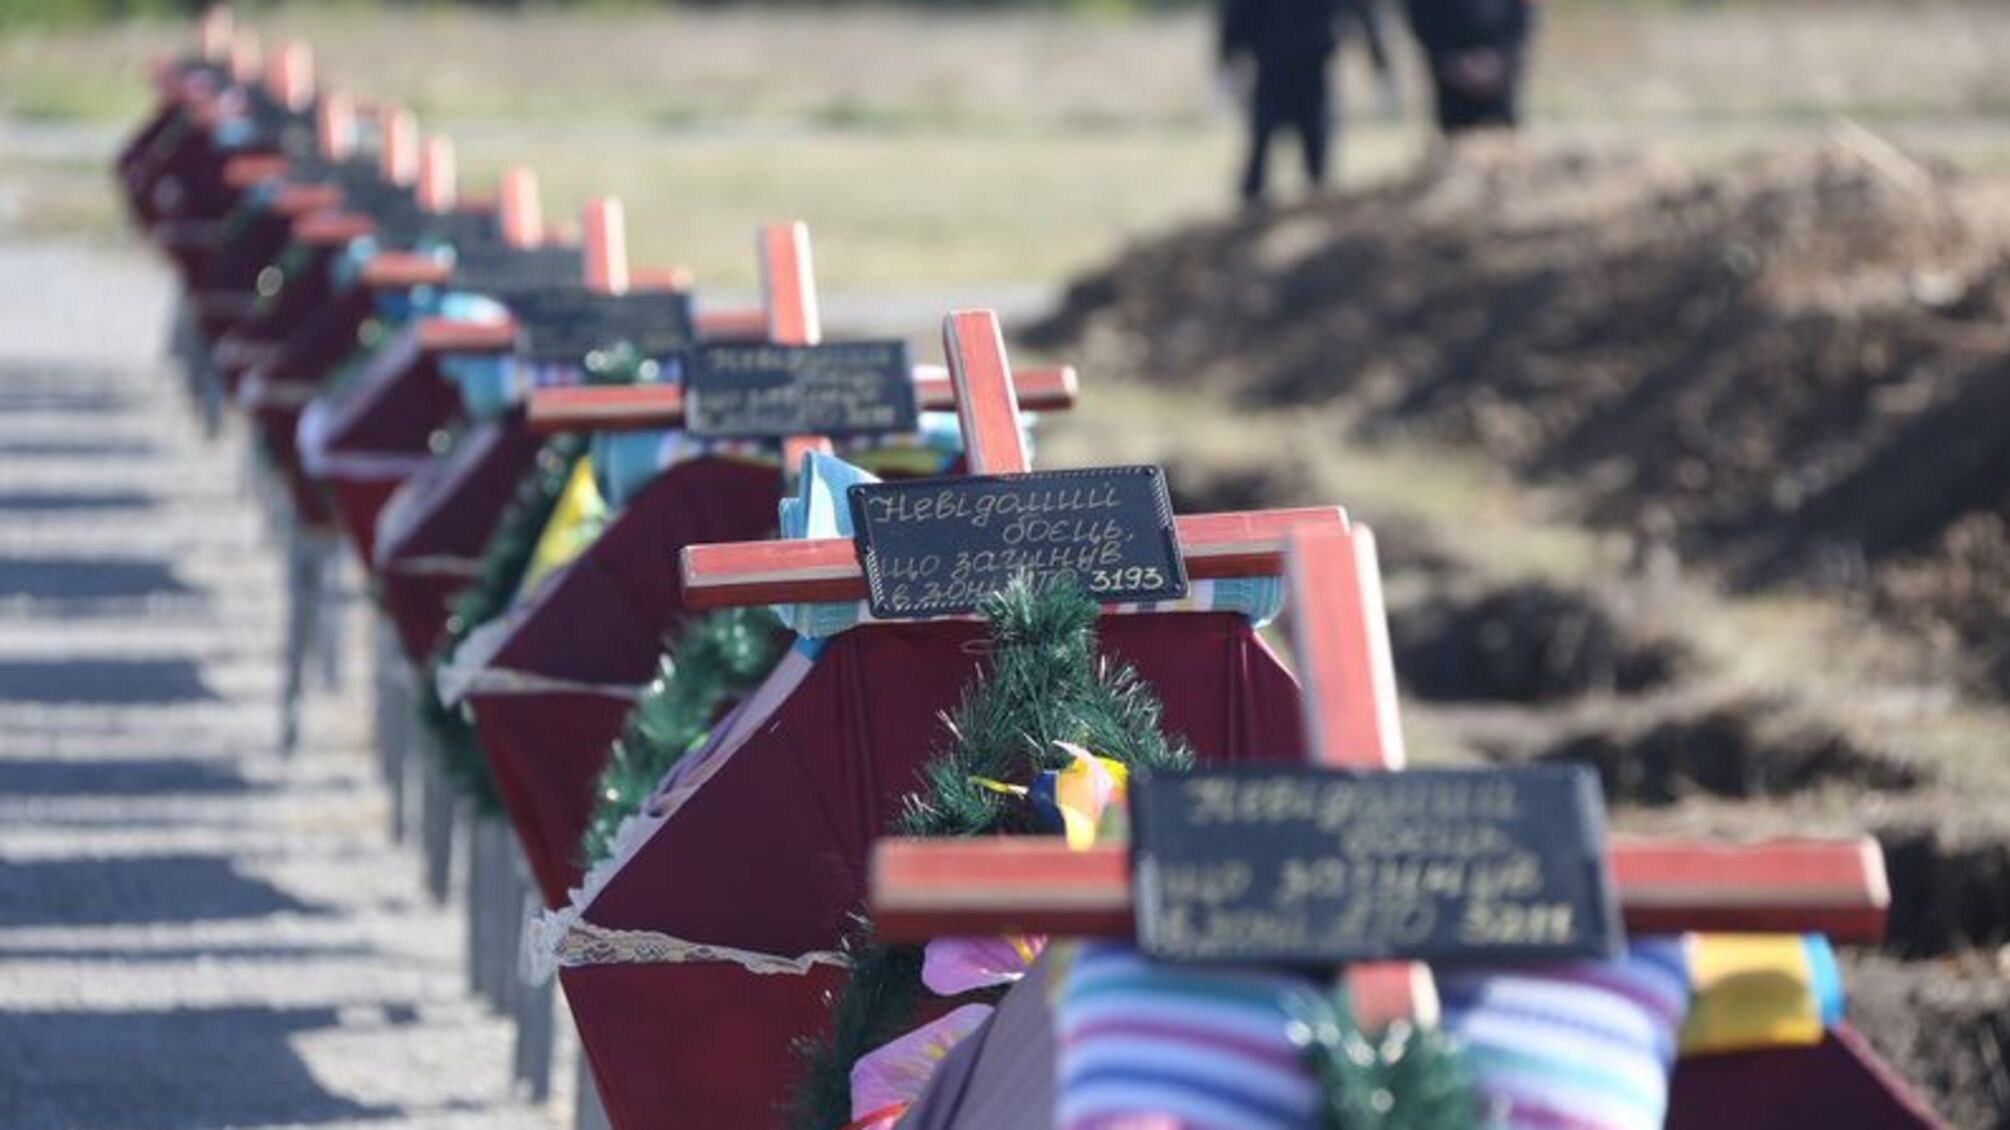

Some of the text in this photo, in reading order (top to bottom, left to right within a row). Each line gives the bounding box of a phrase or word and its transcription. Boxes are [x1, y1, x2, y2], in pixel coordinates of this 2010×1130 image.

[869, 483, 1121, 527] Невідомий
[1002, 514, 1133, 545] боєць,
[882, 541, 1122, 581] що загинув
[1089, 566, 1164, 592] 3193
